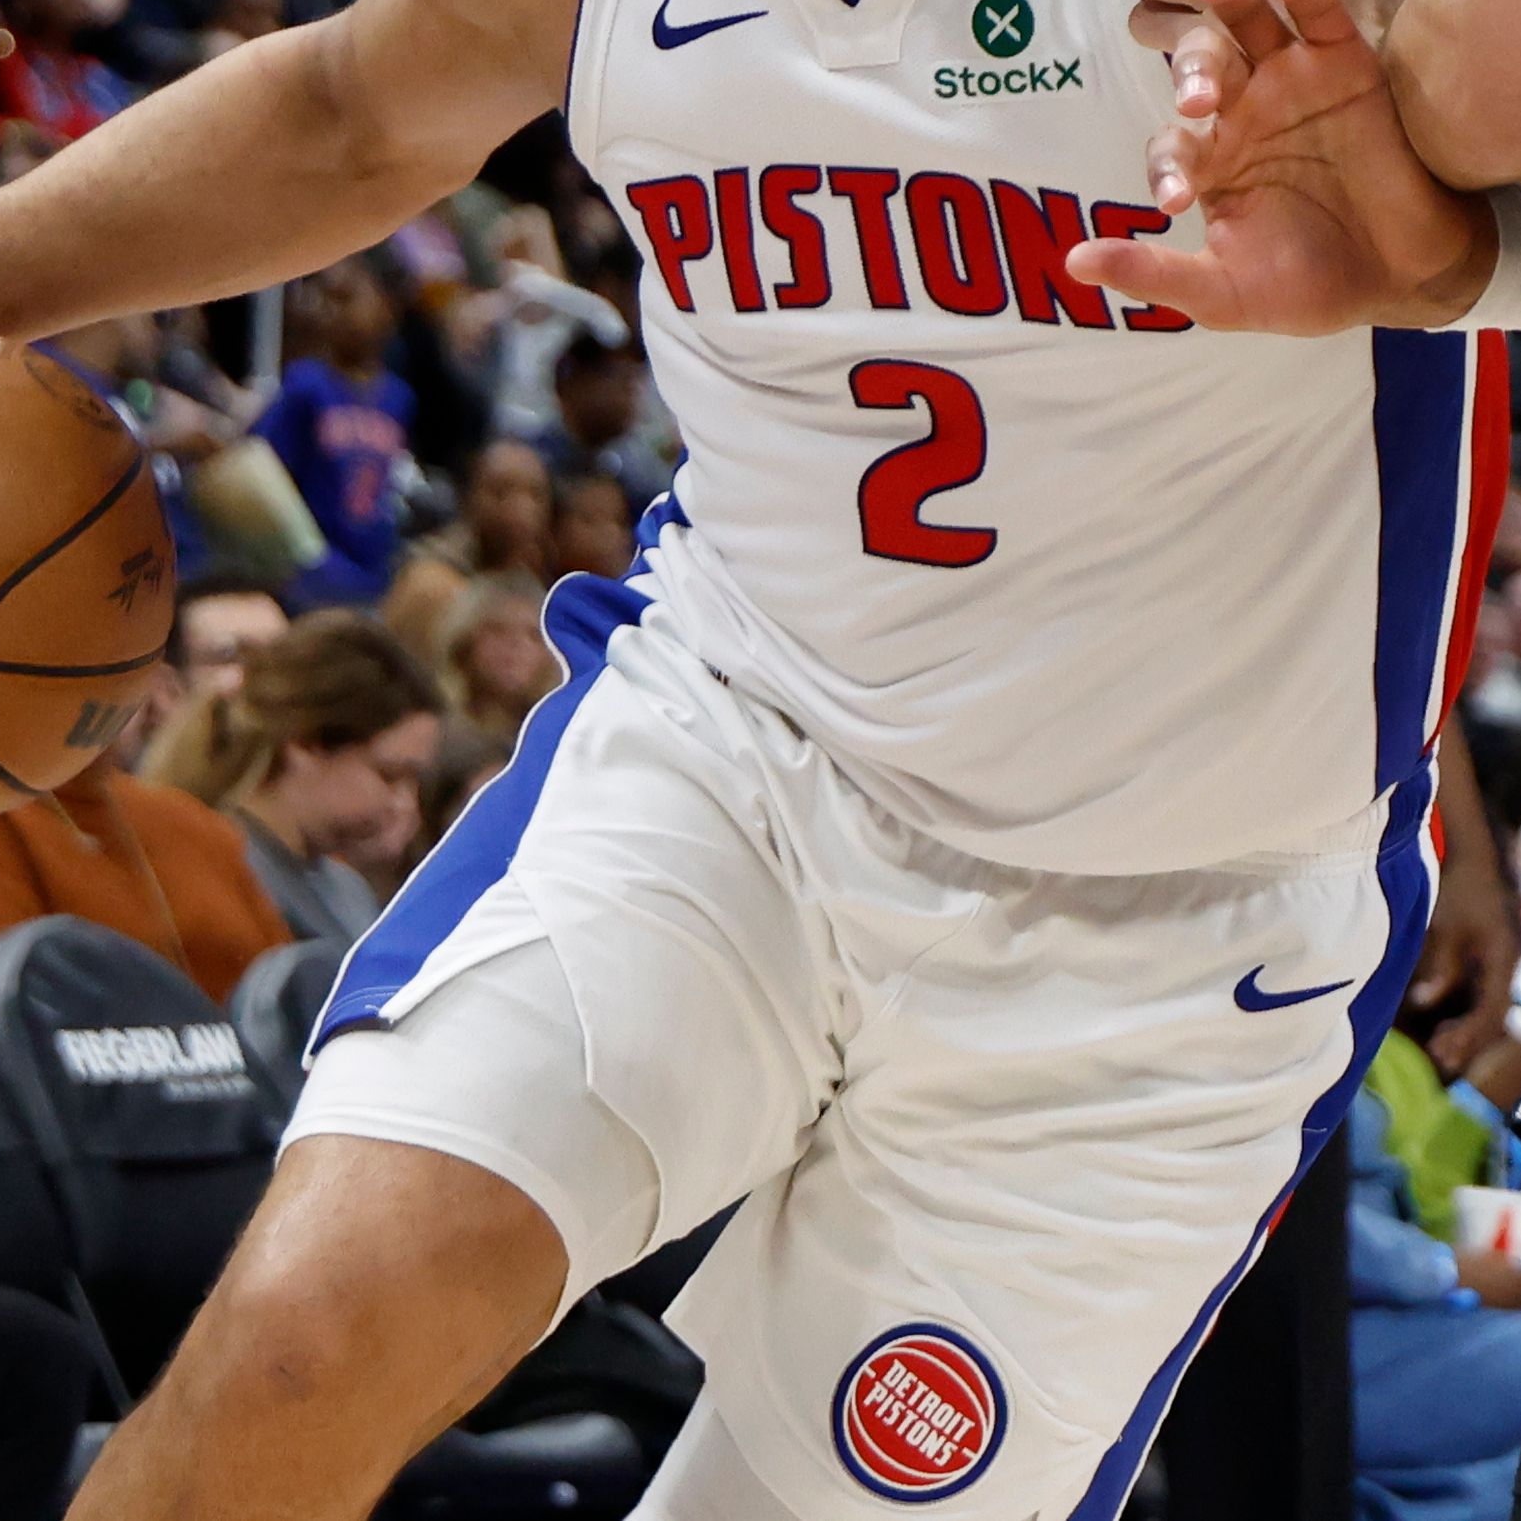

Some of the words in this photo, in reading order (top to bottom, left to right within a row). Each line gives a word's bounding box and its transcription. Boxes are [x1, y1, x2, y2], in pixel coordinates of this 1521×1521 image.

[934, 56, 1084, 99] StockX
[848, 358, 998, 568] 2
[863, 1381, 959, 1468] PISTONS
[883, 1358, 976, 1443] DETROIT
